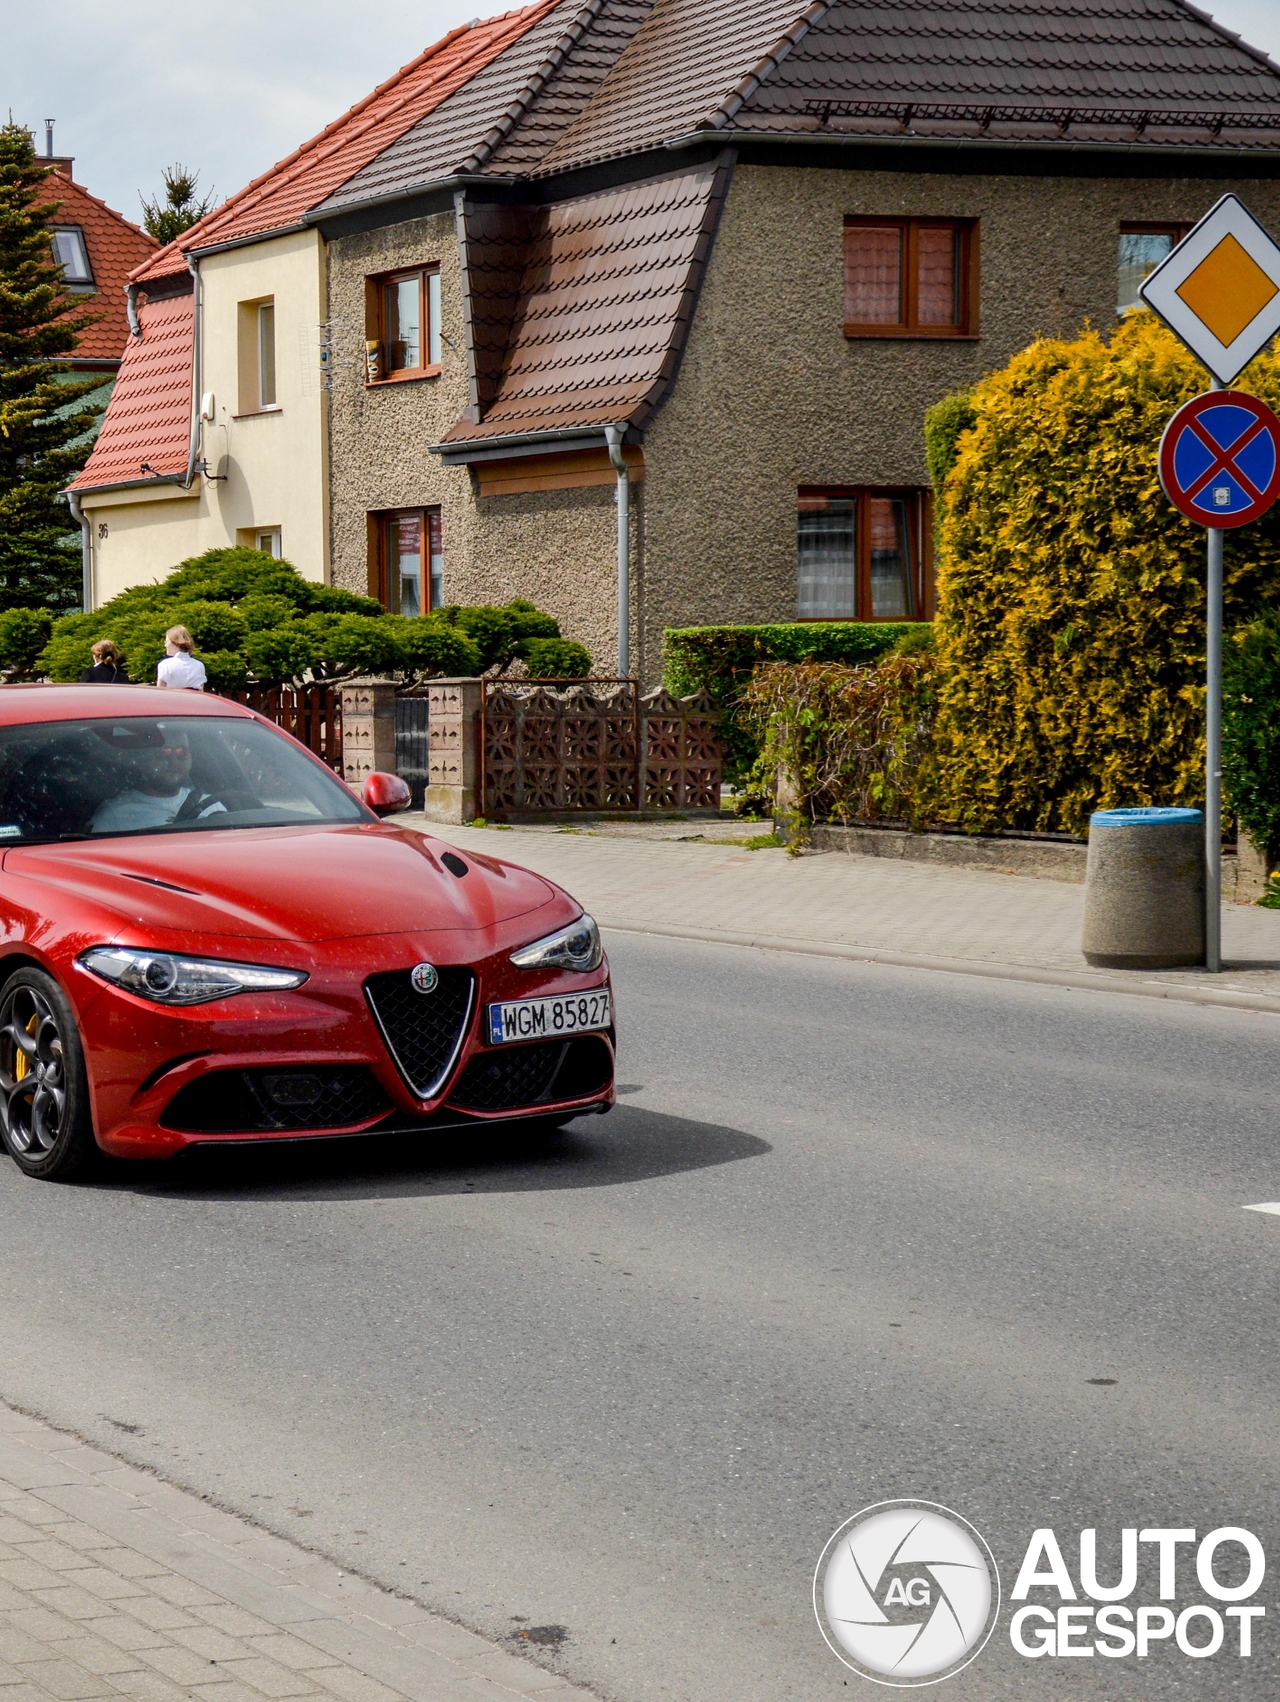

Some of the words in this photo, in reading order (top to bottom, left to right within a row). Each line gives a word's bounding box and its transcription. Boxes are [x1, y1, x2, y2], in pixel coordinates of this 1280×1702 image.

[98, 523, 109, 540] 36
[504, 1004, 546, 1037] WGM
[552, 994, 609, 1030] 85827
